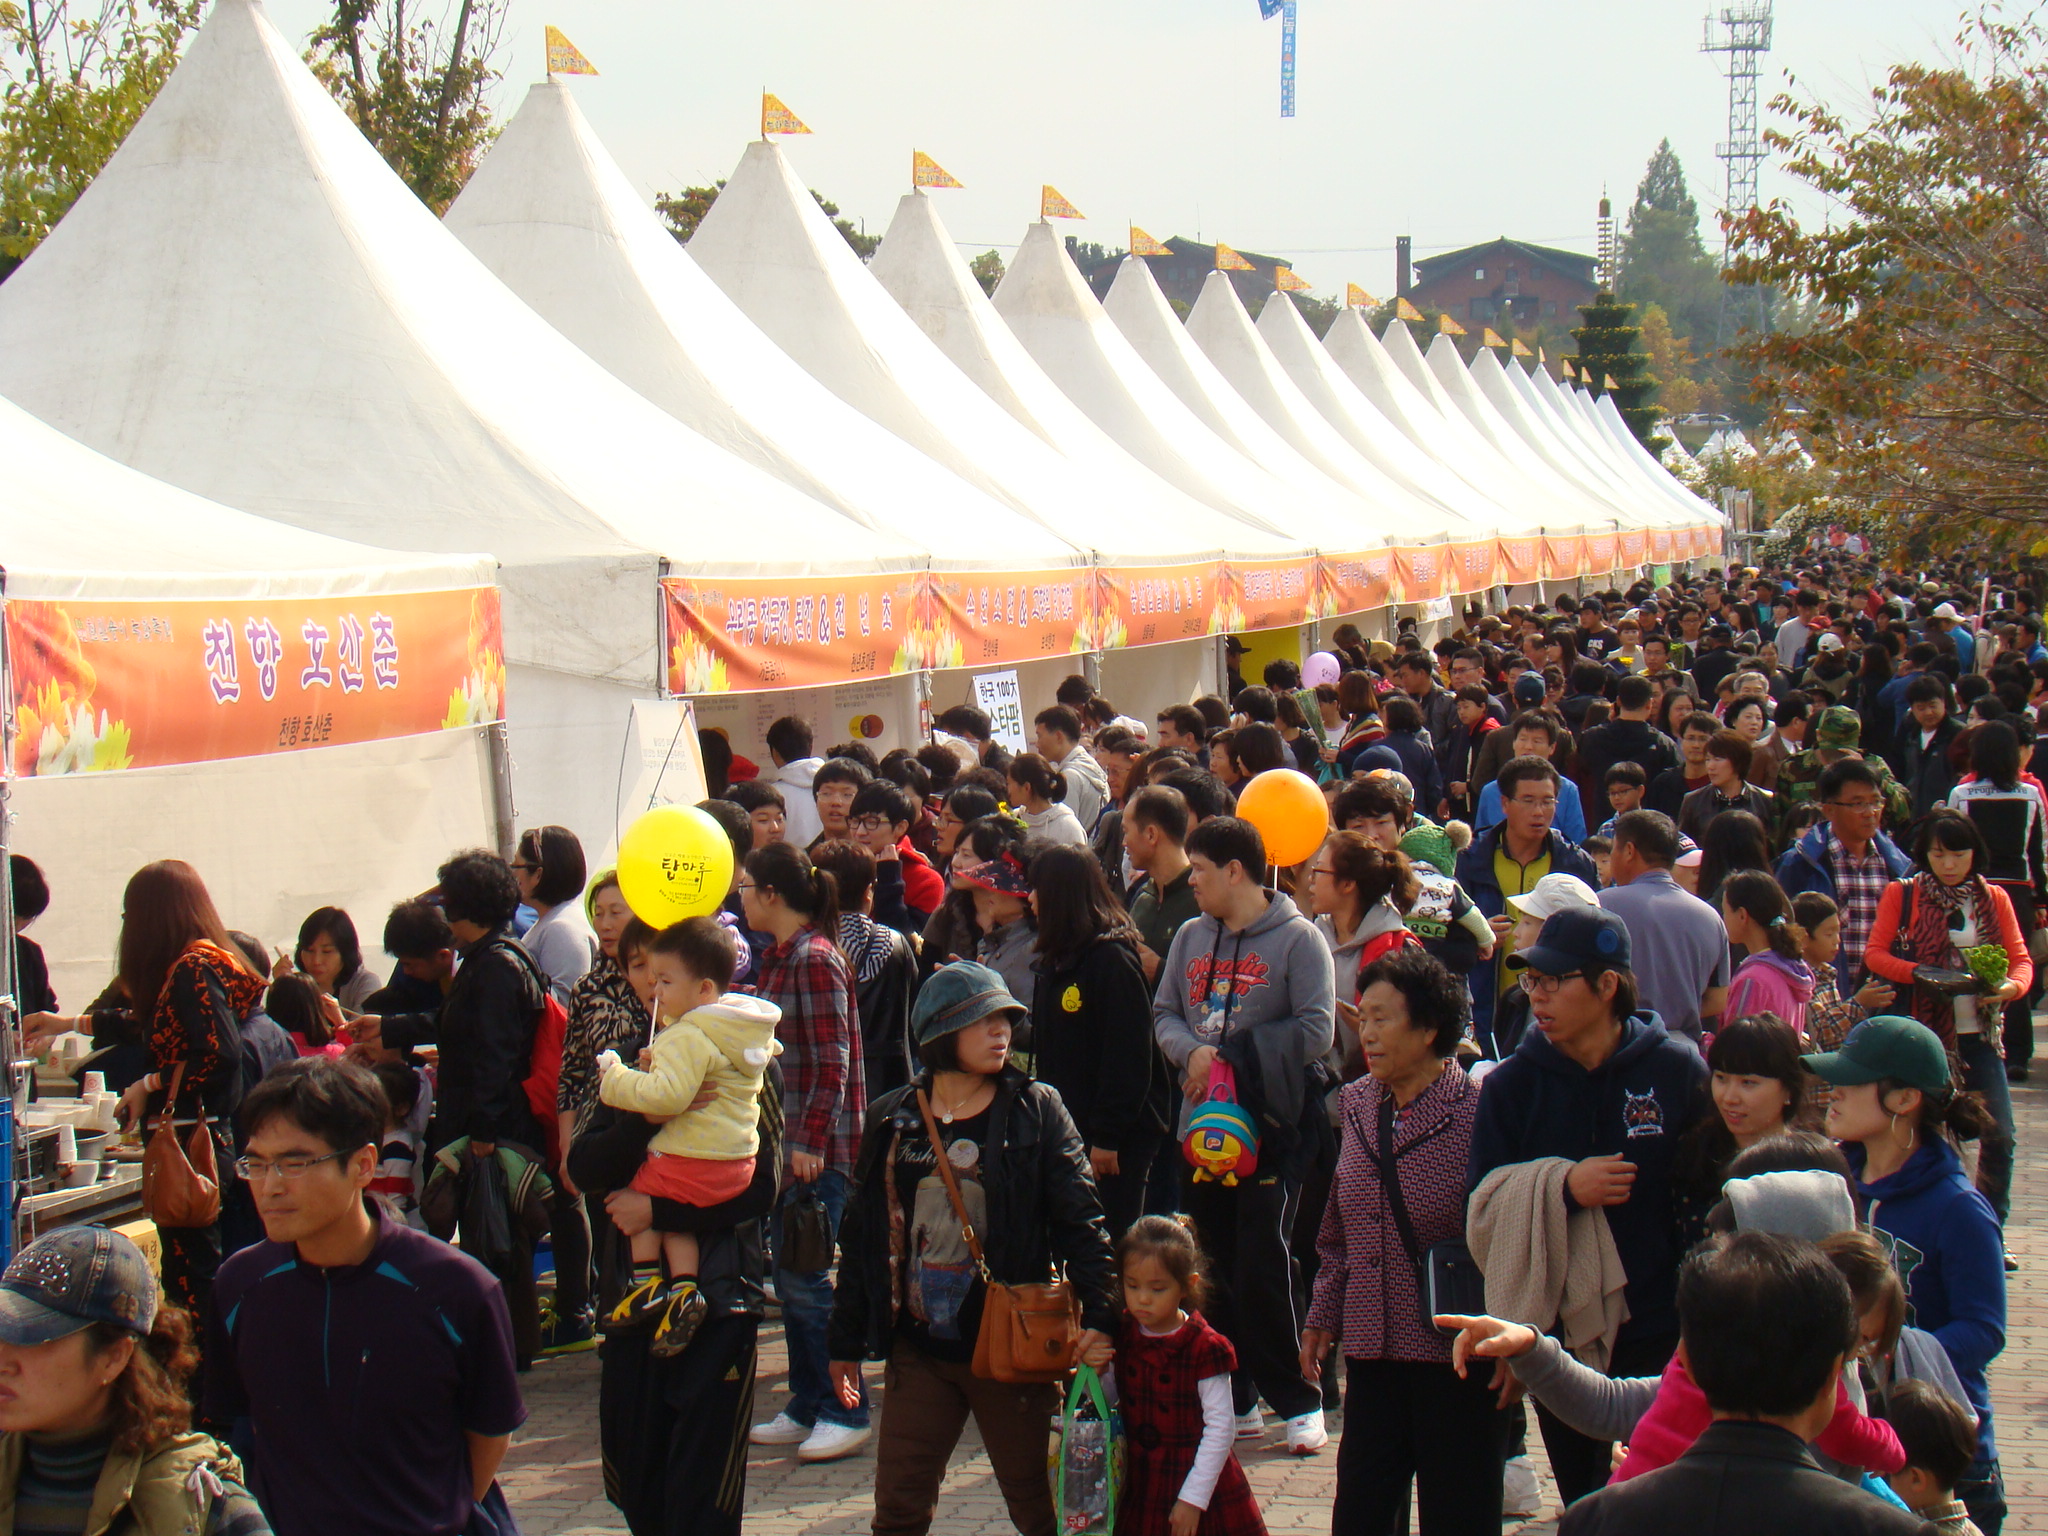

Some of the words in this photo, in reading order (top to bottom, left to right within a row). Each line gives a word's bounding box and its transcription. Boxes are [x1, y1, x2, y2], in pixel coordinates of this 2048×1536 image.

[203, 616, 283, 705] 천향
[300, 611, 400, 695] 호산춘
[979, 681, 996, 703] 한국
[279, 716, 301, 747] 천향
[301, 712, 333, 743] 호산춘
[1967, 786, 2028, 796] Progreive
[662, 857, 713, 893] 탑마루
